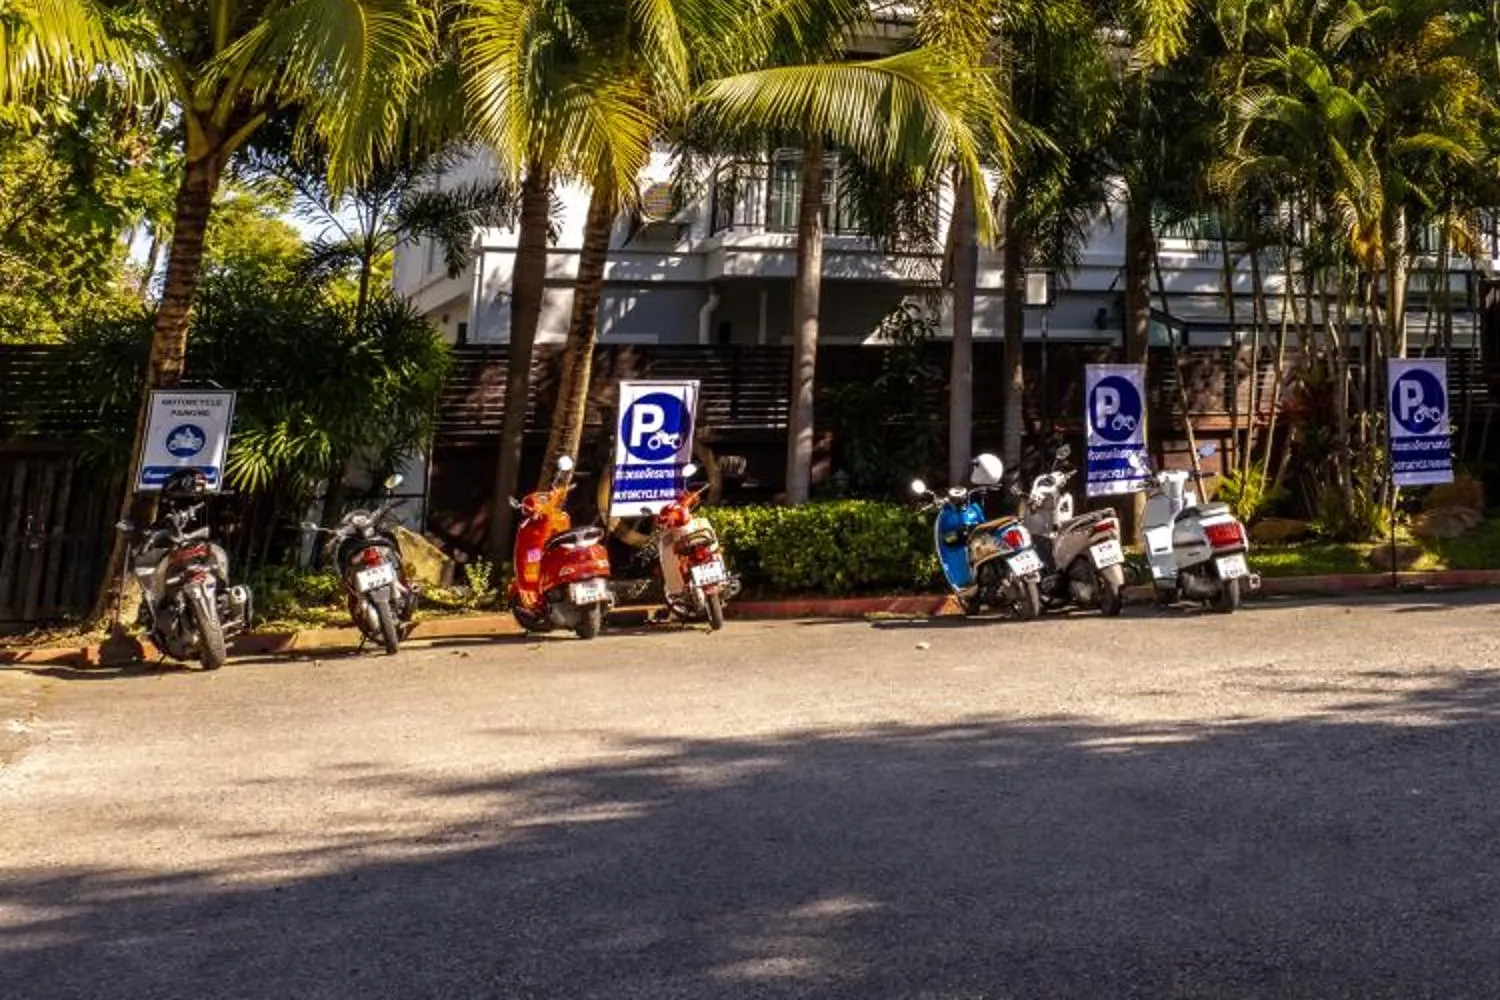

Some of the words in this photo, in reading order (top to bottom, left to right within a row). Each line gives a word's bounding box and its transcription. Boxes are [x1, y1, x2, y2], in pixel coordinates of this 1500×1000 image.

[1096, 387, 1120, 428] P
[1400, 380, 1424, 421] P
[630, 403, 665, 447] P
